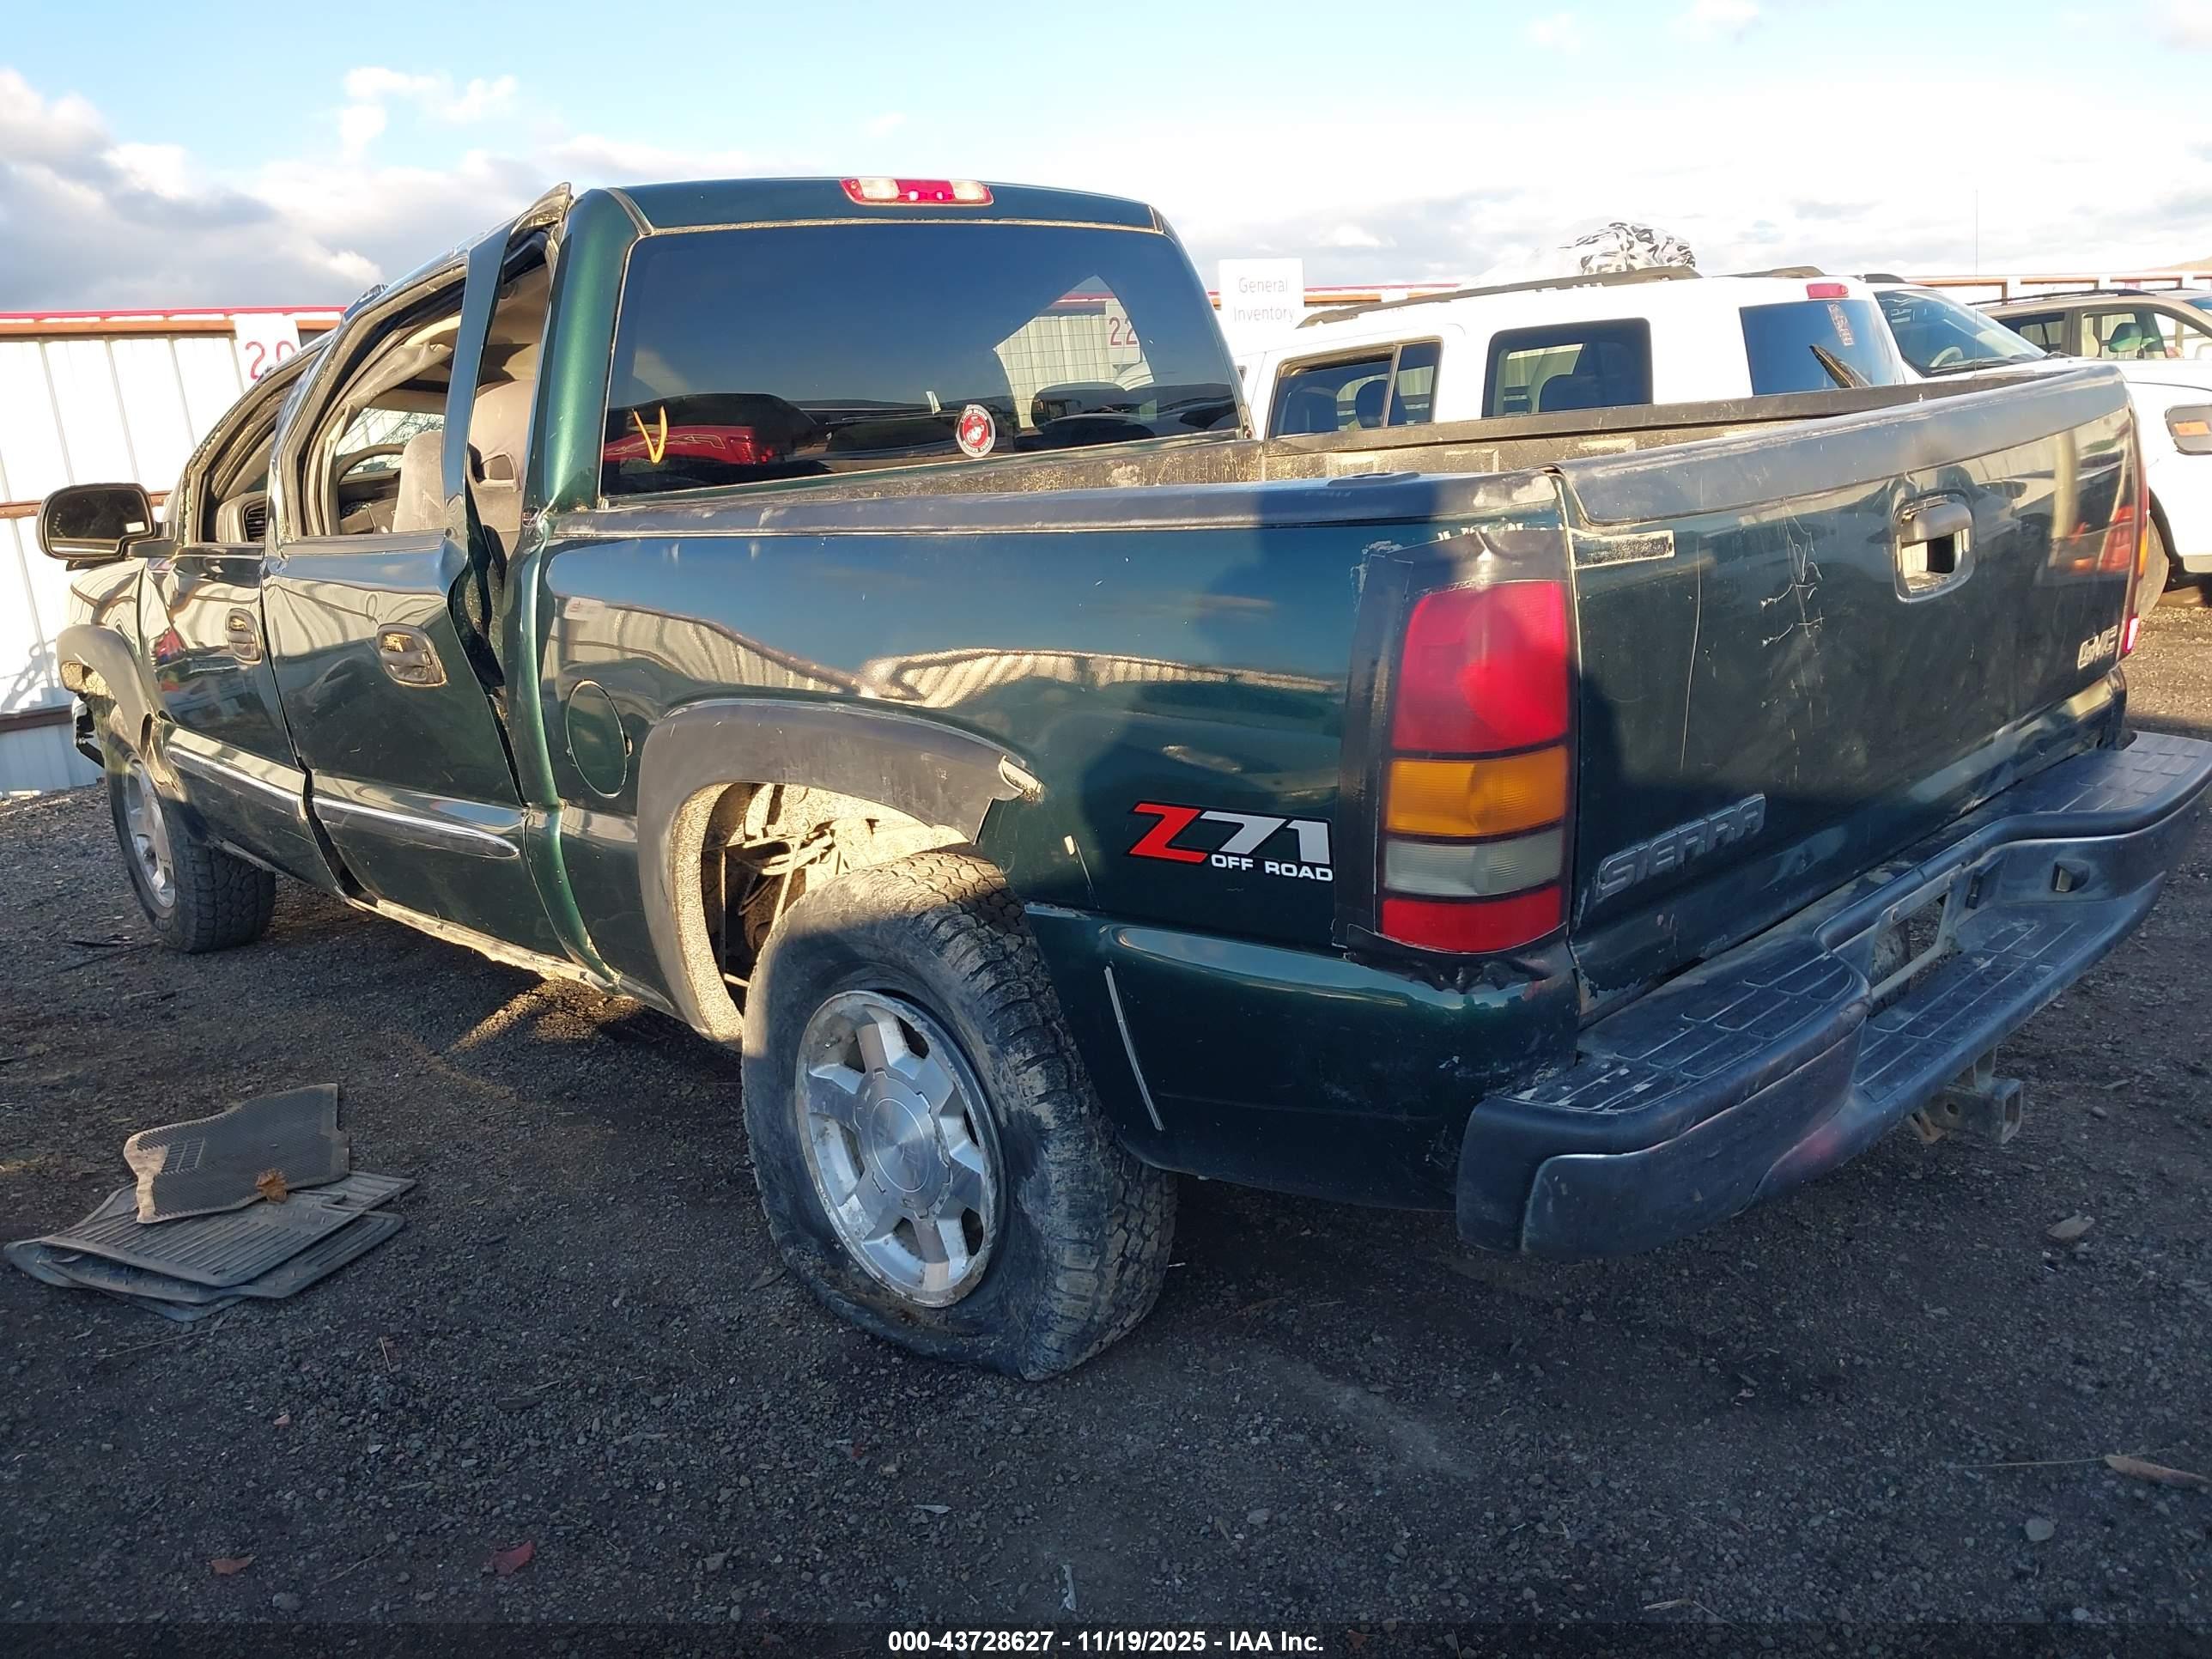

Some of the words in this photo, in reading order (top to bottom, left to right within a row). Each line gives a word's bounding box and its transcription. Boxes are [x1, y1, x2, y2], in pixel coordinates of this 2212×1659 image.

[1238, 276, 1288, 293] General
[1233, 305, 1295, 323] Inventory
[1129, 803, 1330, 864] Z71
[1596, 793, 1766, 902] SIERRA
[1211, 854, 1254, 872] OFF
[1264, 860, 1334, 882] ROAD
